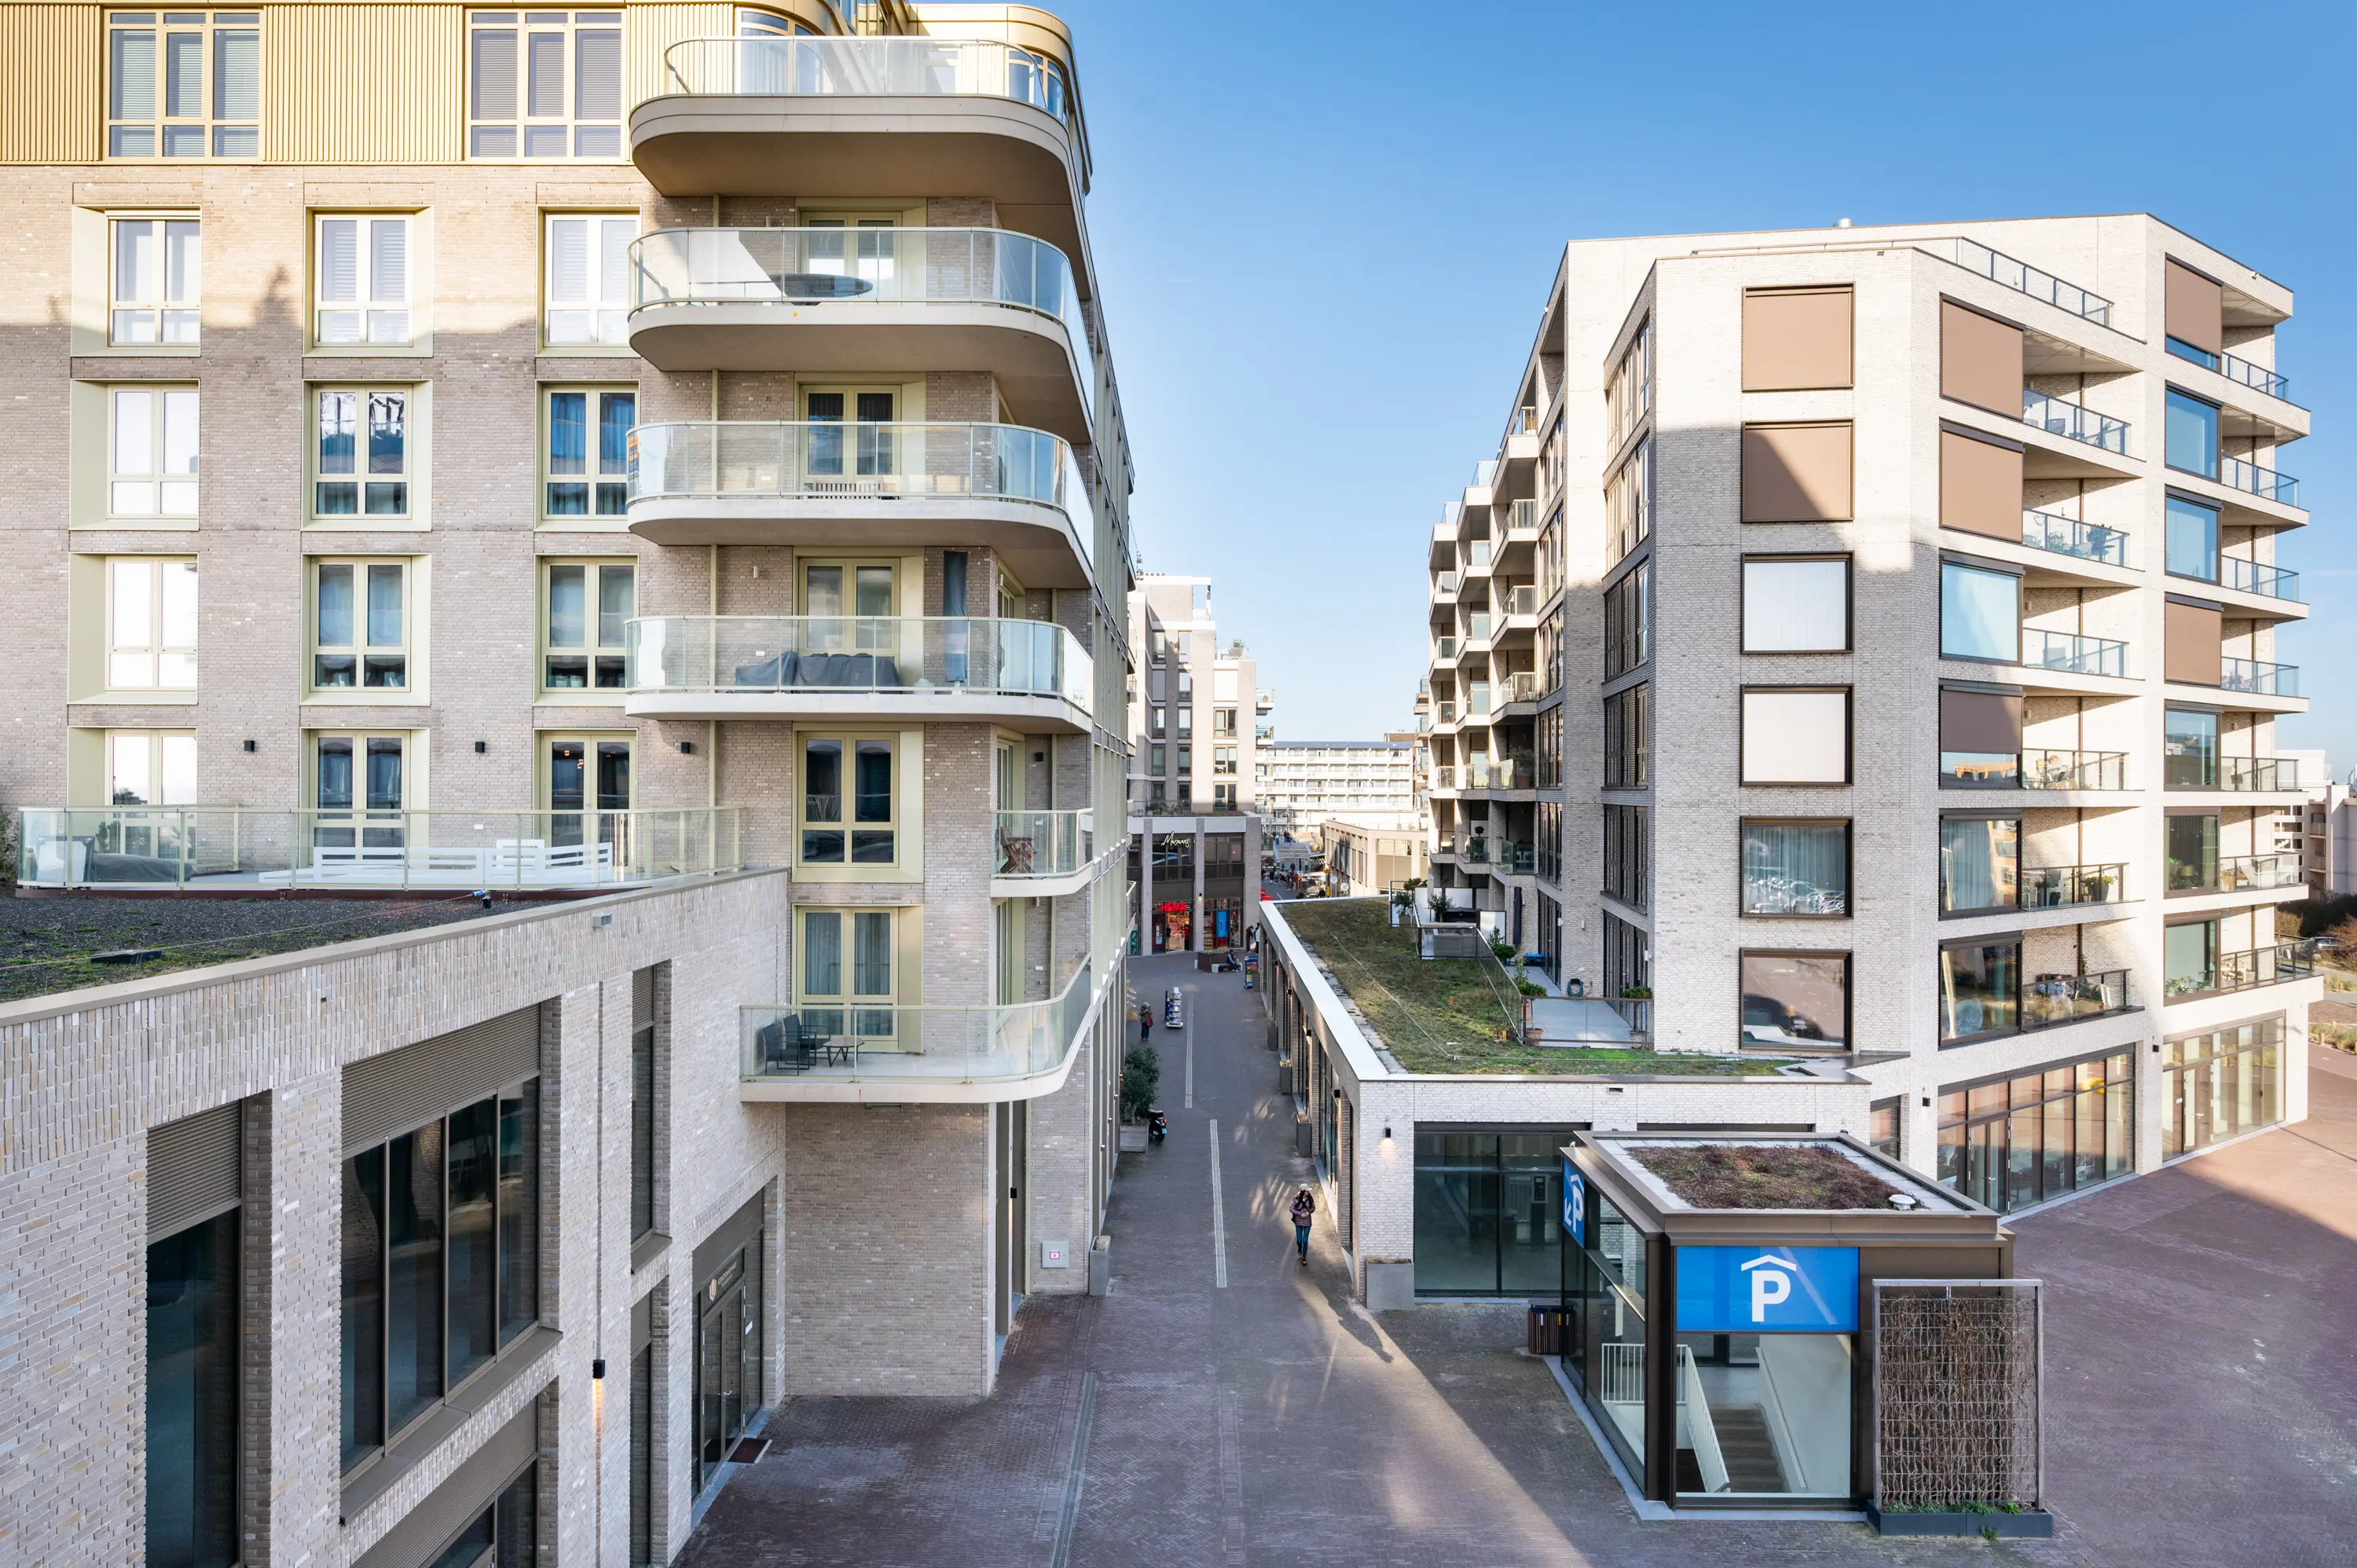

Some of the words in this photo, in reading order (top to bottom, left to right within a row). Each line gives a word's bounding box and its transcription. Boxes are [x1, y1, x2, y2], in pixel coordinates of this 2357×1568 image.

[1160, 903, 1186, 912] HEMA
[1573, 1185, 1584, 1233] P
[1752, 1270, 1791, 1322] P
